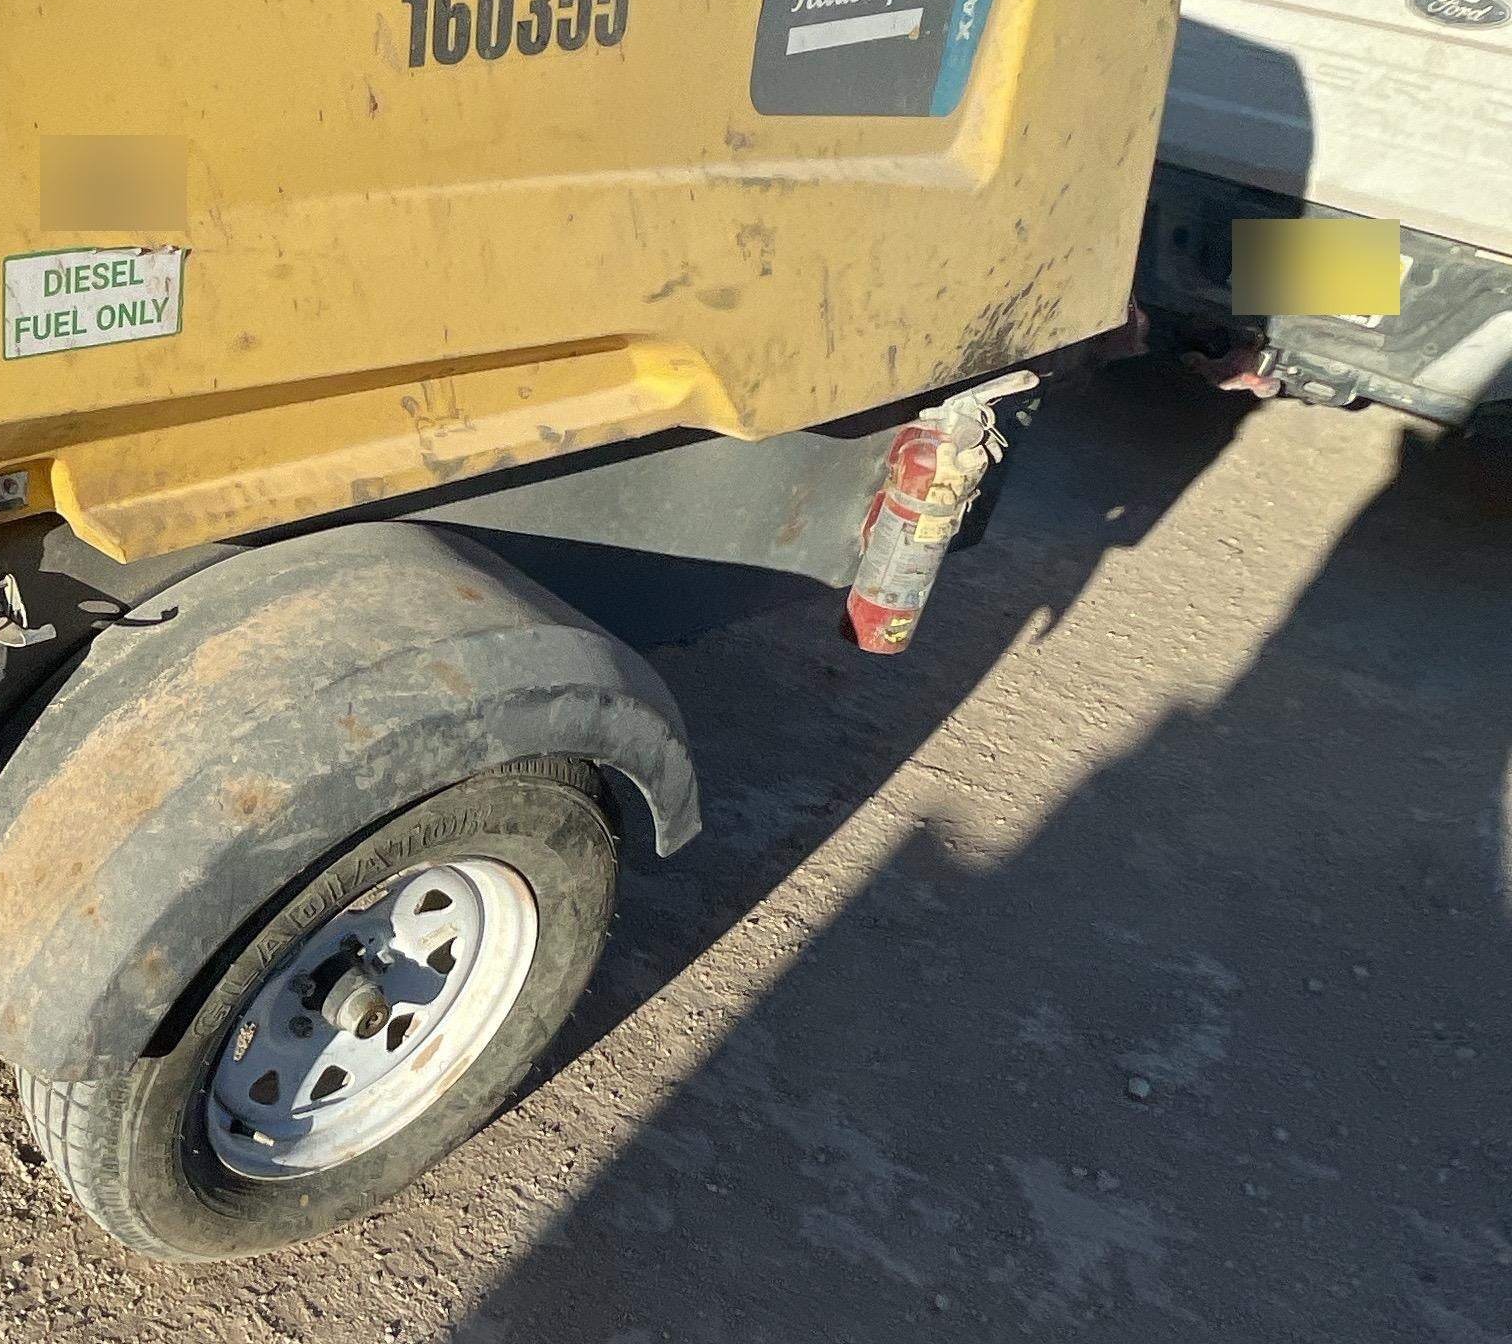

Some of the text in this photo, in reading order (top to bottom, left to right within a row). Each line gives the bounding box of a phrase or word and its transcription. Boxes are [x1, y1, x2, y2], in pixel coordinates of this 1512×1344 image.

[43, 259, 144, 298] DIESEL
[14, 296, 170, 344] FUEL ONLY
